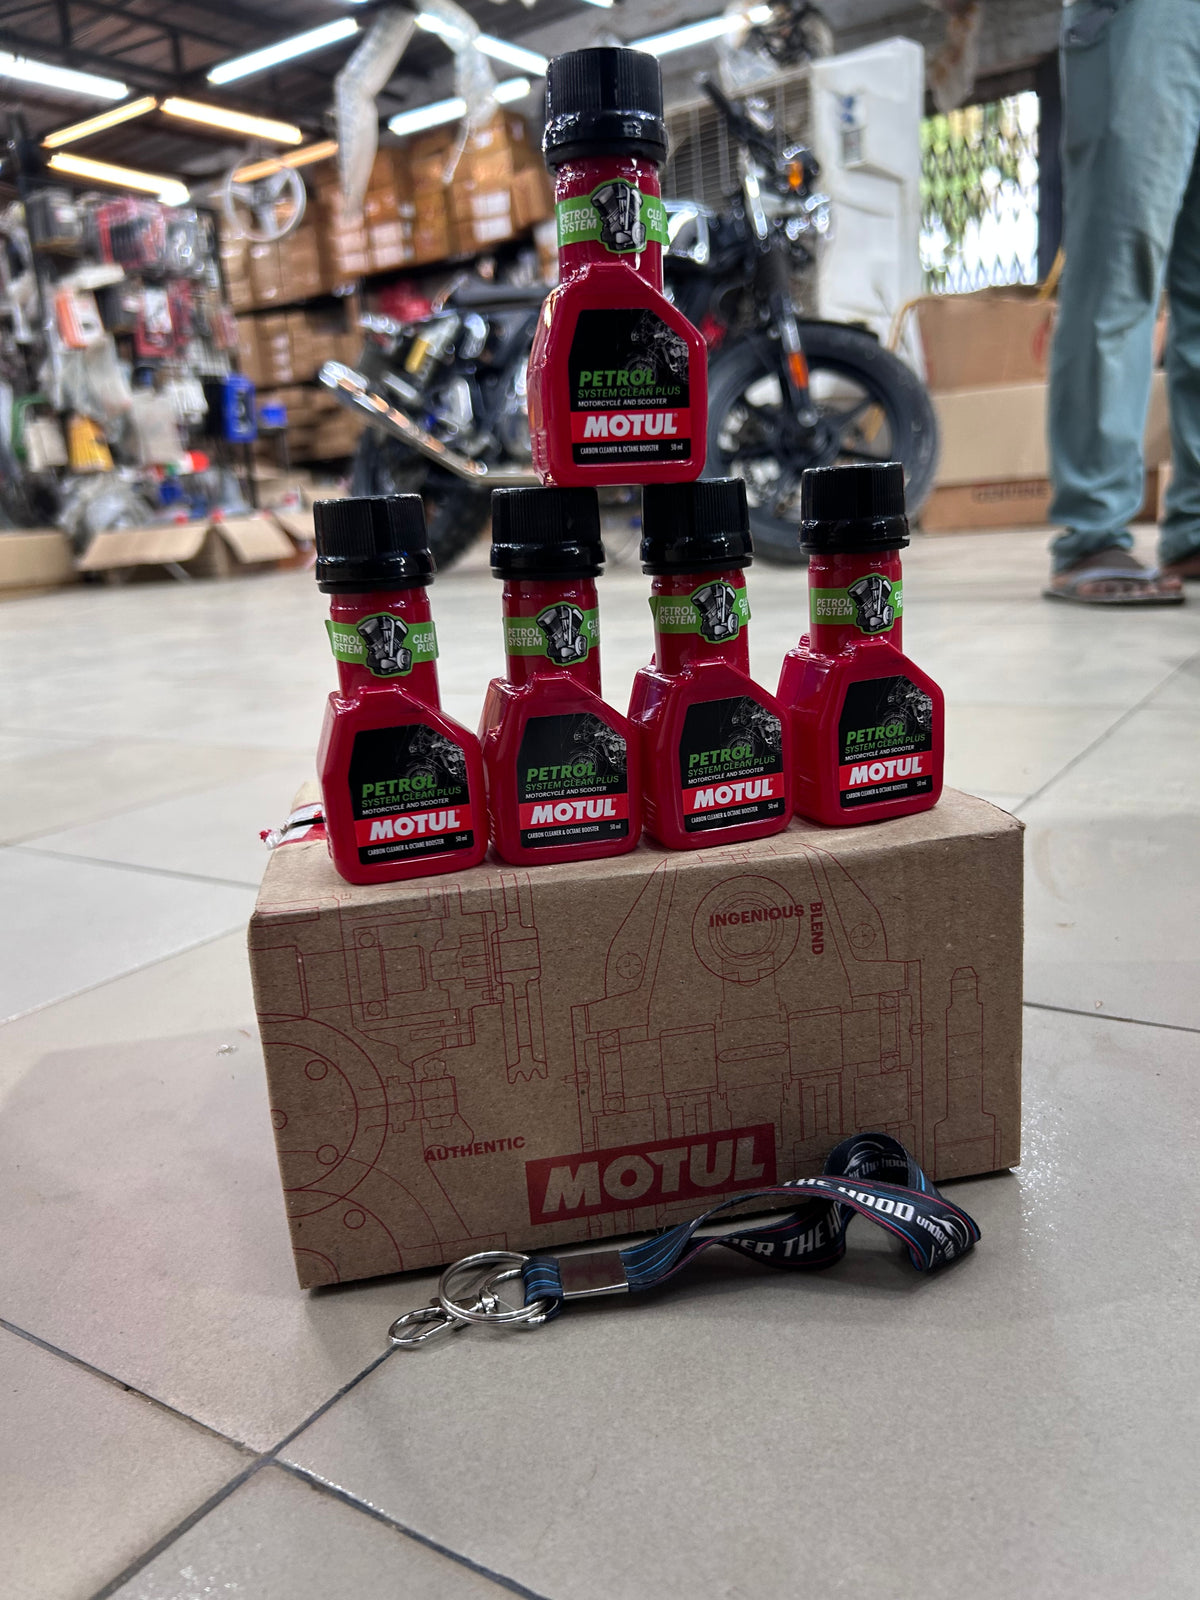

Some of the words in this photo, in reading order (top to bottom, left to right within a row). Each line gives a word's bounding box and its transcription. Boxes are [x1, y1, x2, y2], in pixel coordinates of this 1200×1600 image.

[561, 208, 596, 223] PETROL
[560, 219, 597, 235] SYSTEM
[579, 369, 655, 387] PETROL
[578, 388, 617, 399] SYSTEM
[620, 387, 654, 397] CLEAN
[656, 386, 680, 395] PLUS
[583, 413, 677, 438] MOTUL
[660, 606, 695, 616] PETROL
[816, 598, 852, 607] PETROL
[816, 607, 853, 616] SYSTEM
[660, 615, 697, 625] SYSTEM
[507, 627, 542, 637] PETROL
[508, 637, 542, 647] SYSTEM
[417, 642, 435, 654] PLUS
[846, 722, 906, 745] PETROL
[845, 742, 875, 754] SYSTEM
[877, 737, 903, 748] CLEAN
[905, 734, 926, 744] PLUS
[845, 750, 878, 761] MOTORCYCLE
[891, 745, 915, 753] SCOOTER
[688, 744, 754, 768] PETROL
[527, 762, 596, 782] PETROL
[687, 765, 721, 777] SYSTEM
[723, 760, 752, 771] CLEAN
[754, 756, 776, 766] PLUS
[688, 773, 725, 785] MOTORCYCLE
[738, 767, 764, 776] SCOOTER
[849, 757, 922, 786] MOTUL
[362, 775, 437, 798] PETROL
[525, 781, 561, 792] SYSTEM
[563, 778, 594, 788] CLEAN
[596, 775, 619, 785] PLUS
[362, 794, 400, 808] SYSTEM
[402, 790, 435, 802] CLEAN
[437, 786, 461, 796] PLUS
[525, 790, 564, 799] MOTORCYCLE
[693, 779, 773, 810] MOTUL
[362, 803, 405, 815] MOTORCYCLE
[406, 801, 420, 809] AND
[421, 798, 449, 807] SCOOTER
[530, 799, 616, 825] MOTUL
[370, 810, 460, 841] MOTUL
[709, 904, 804, 928] INGENIOUS
[810, 902, 824, 955] BLEND
[424, 1135, 526, 1163] AUTHENTIC
[542, 1135, 765, 1213] MOTUL
[783, 1219, 826, 1258] THE
[916, 1215, 949, 1246] under
